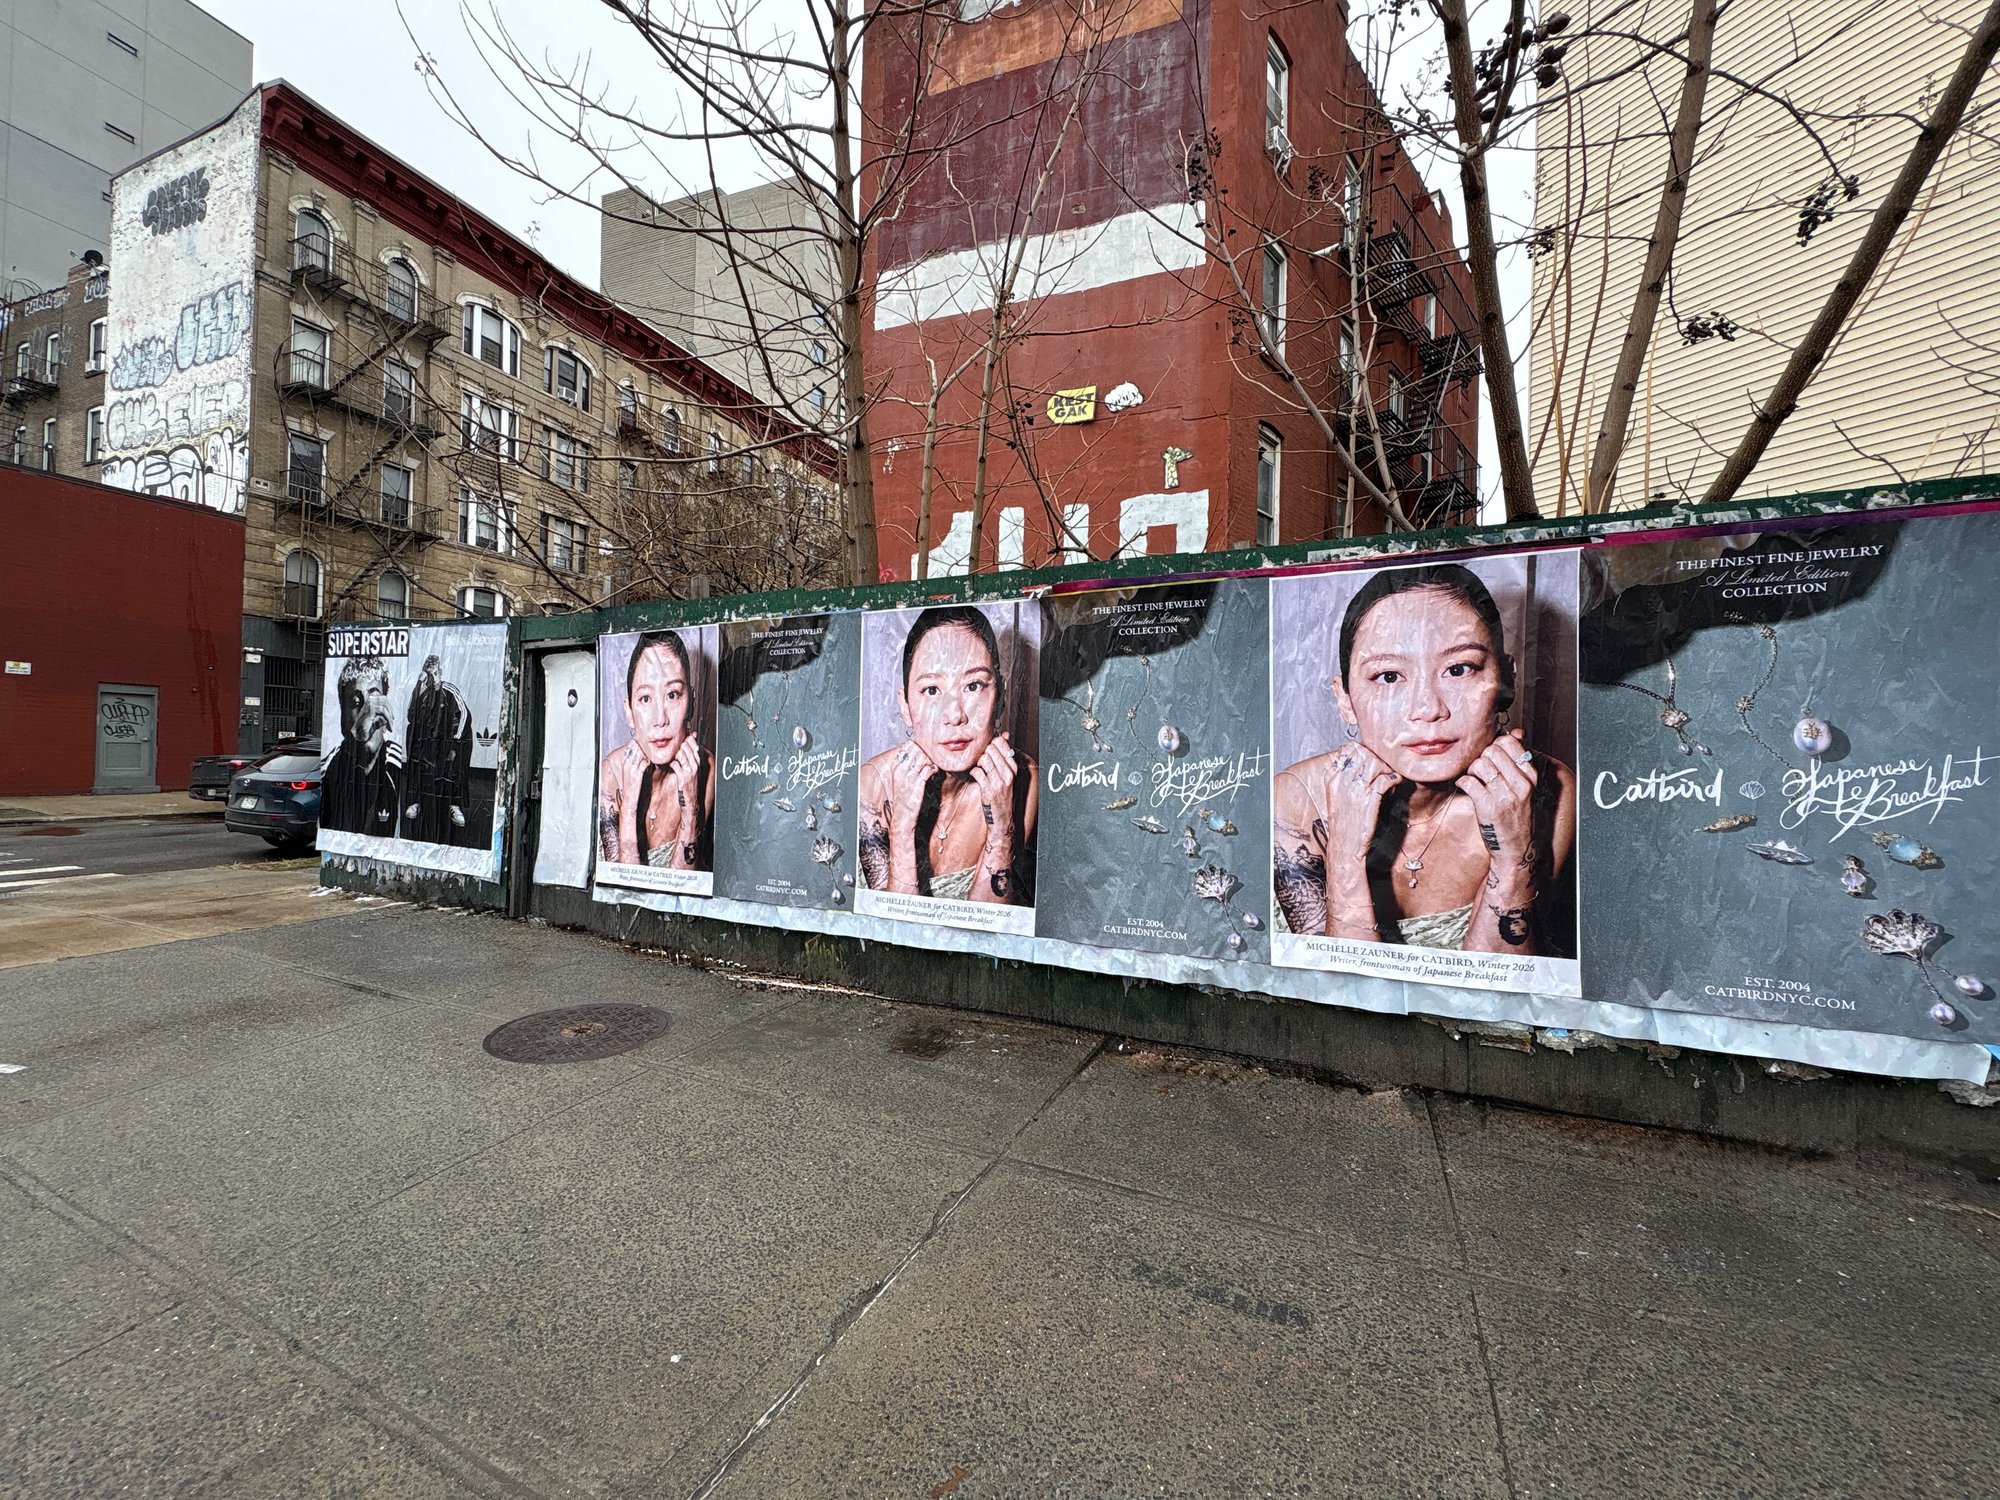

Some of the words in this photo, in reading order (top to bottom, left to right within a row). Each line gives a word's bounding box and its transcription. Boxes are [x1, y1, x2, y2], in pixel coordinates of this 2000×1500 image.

[1055, 404, 1087, 418] GAK
[1676, 560, 1707, 570] THE
[1710, 554, 1764, 568] FINEST
[1768, 552, 1804, 564] FINE
[1808, 545, 1884, 562] JEWELRY
[1700, 570, 1730, 588] A
[1725, 569, 1790, 585] Limited
[1790, 565, 1852, 581] Edition
[1722, 582, 1828, 599] COLLECTION
[1112, 604, 1142, 613] FINEST
[1144, 602, 1163, 611] FINE
[1164, 599, 1207, 611] JEWELRY
[1107, 614, 1122, 628] A
[1120, 614, 1156, 626] Limited
[1157, 612, 1190, 624] Edition
[1118, 625, 1178, 636] COLLECTION
[328, 630, 408, 656] SUPERSTAR
[769, 648, 806, 656] COLLECTION
[722, 755, 769, 780] Catbird
[1048, 762, 1120, 792] Catbird
[1594, 768, 1724, 809] Catbird
[937, 911, 944, 919] of
[976, 908, 996, 916] Winter
[1127, 918, 1144, 926] EST.
[1146, 920, 1164, 928] 2004
[1104, 925, 1188, 940] CATBIRDNYC.COM
[1306, 942, 1359, 954] MICHELLE
[1360, 947, 1405, 960] ZAUNER
[1406, 952, 1420, 962] for
[1422, 955, 1475, 968] CATBIRD,
[1477, 959, 1511, 970] Winter
[1513, 963, 1535, 972] 2026
[1330, 955, 1358, 966] Writer,
[1358, 959, 1412, 972] frontwoman
[1413, 965, 1423, 975] of
[1422, 967, 1463, 978] Japanese
[1464, 971, 1508, 982] Breakfast
[1744, 976, 1775, 988] EST.
[1778, 980, 1811, 992] 2004
[1704, 985, 1856, 1010] CATBIRDNYC.COM
